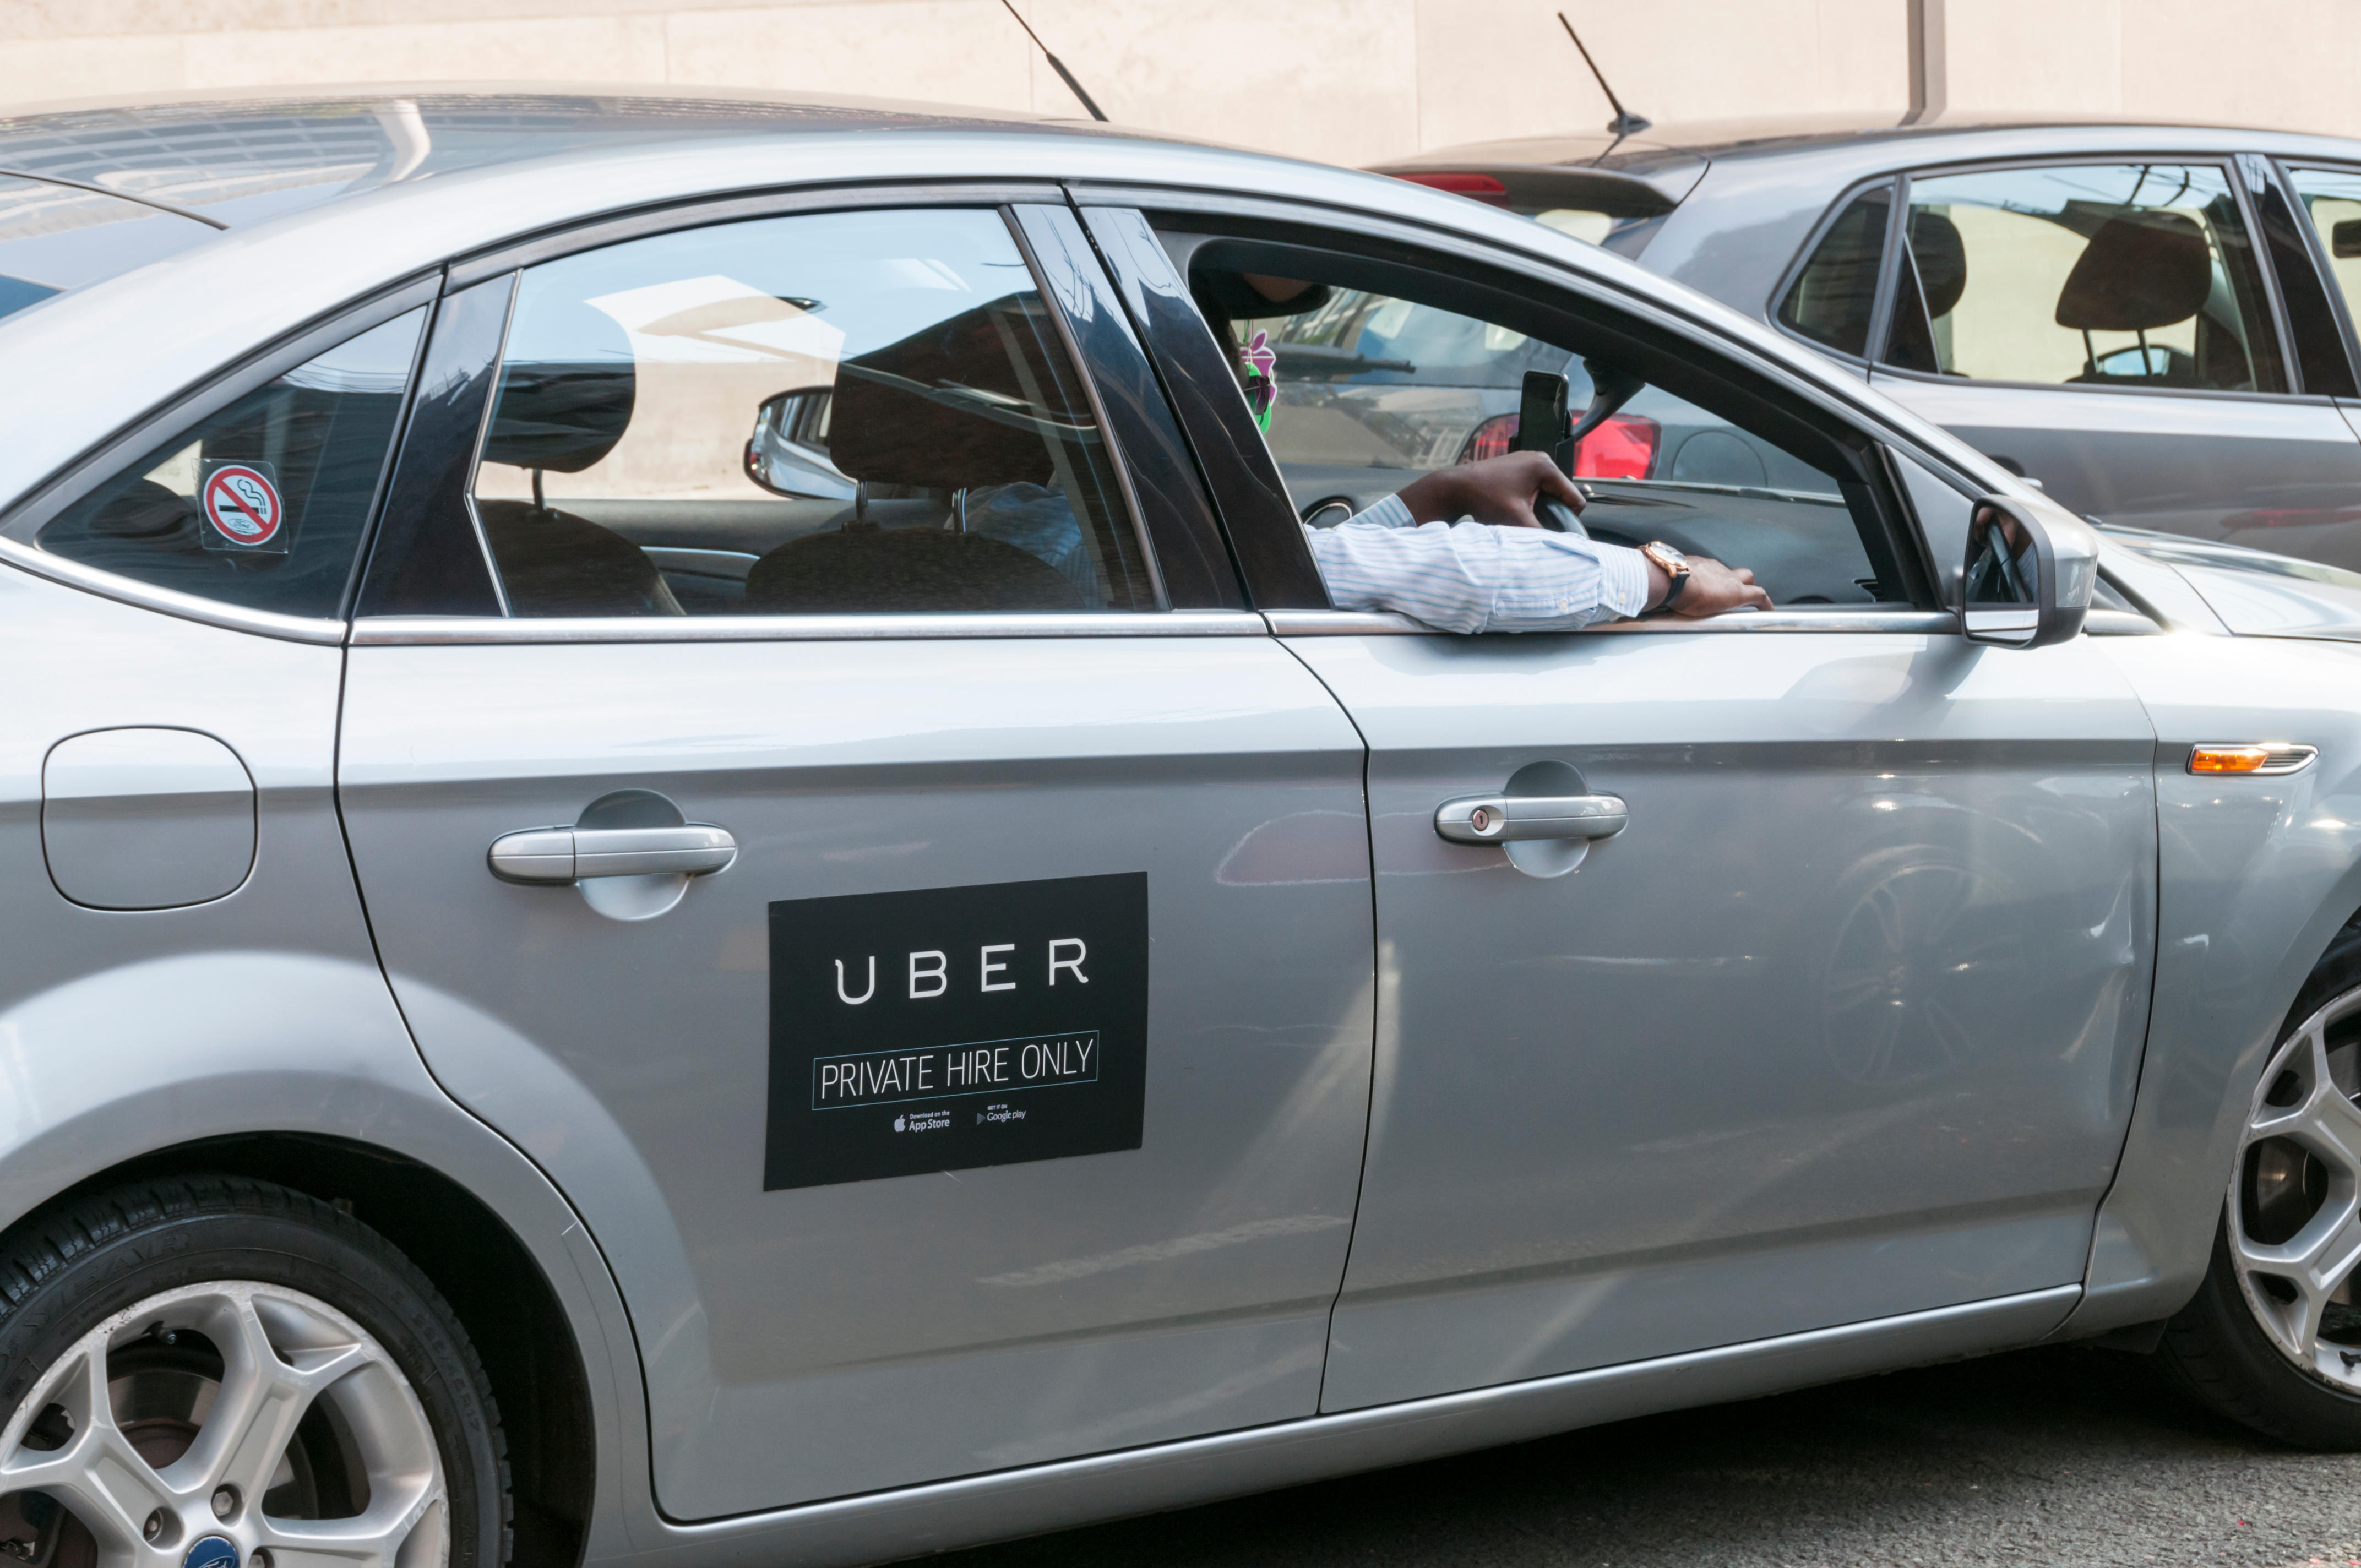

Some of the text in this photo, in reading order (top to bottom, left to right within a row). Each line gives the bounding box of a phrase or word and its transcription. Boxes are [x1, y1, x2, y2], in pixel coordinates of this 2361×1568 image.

[835, 938, 1089, 1005] UBER
[821, 1039, 1094, 1099] PRIVATE HIRE ONLY
[910, 1111, 933, 1119] Download
[987, 1110, 1026, 1123] Google play
[909, 1118, 950, 1133] App Store
